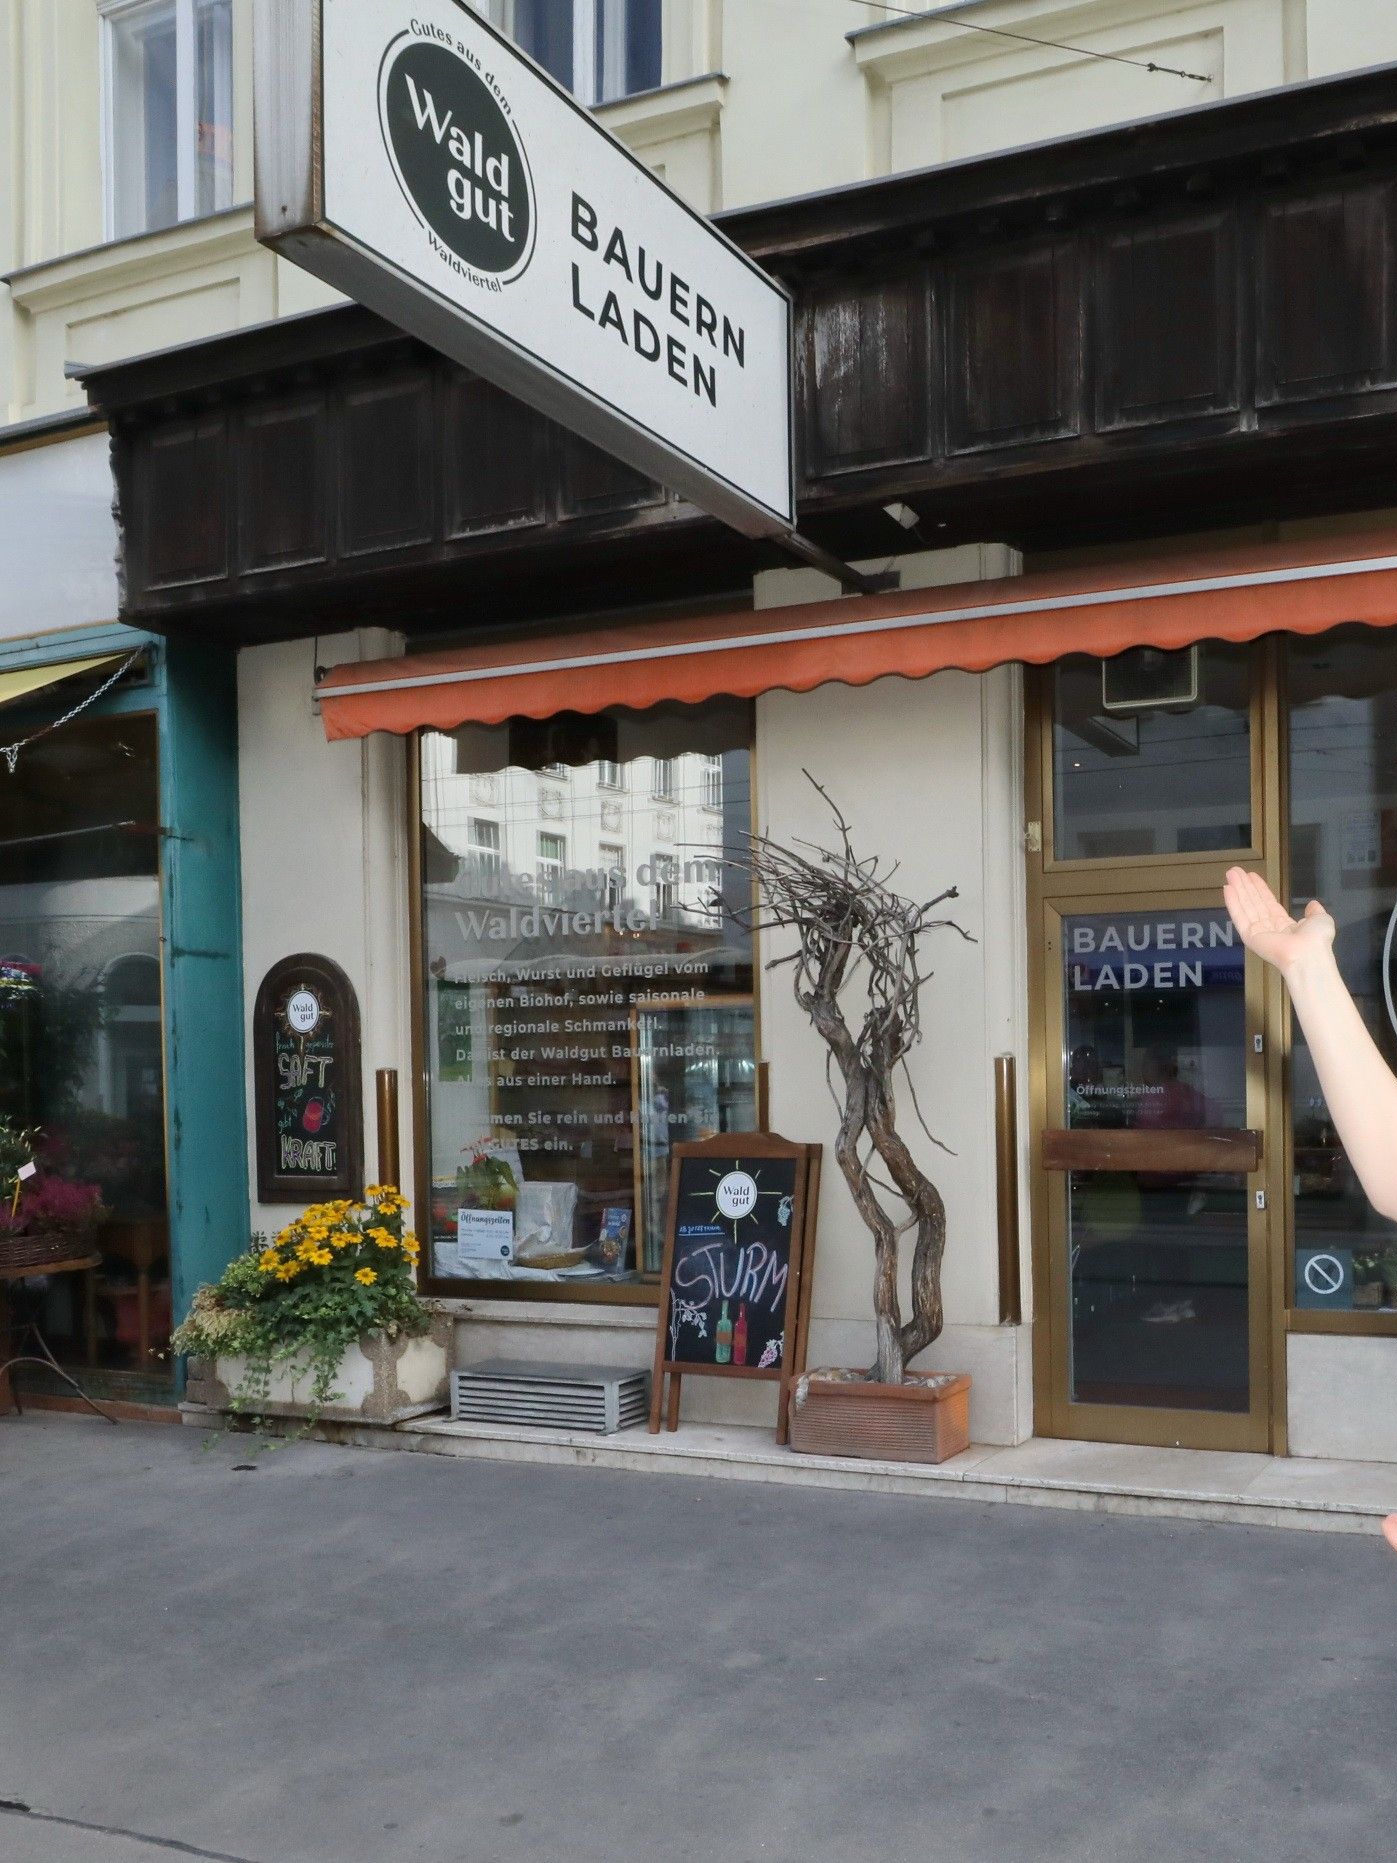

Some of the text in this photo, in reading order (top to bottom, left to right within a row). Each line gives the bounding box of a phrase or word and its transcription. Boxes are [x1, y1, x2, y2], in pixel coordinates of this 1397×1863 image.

[410, 18, 512, 115] Gutes aus dem
[404, 73, 510, 198] Wald
[446, 168, 515, 243] gut
[427, 228, 503, 293] Waldviertel
[571, 190, 745, 370] BAUERN
[571, 262, 717, 408] LADEN
[455, 900, 659, 942] Waldviertel
[1074, 920, 1234, 954] BAUERN
[516, 967, 562, 981] Wurst
[567, 965, 597, 979] und
[602, 961, 669, 979] Geflügel
[674, 962, 710, 975] vom
[1074, 961, 1203, 992] LADEN
[292, 1003, 314, 1013] Wald
[520, 993, 574, 1008] Biohof,
[579, 990, 624, 1005] sowie
[629, 987, 706, 1003] saisonale
[299, 1011, 315, 1022] gut
[489, 1020, 560, 1037] regionale
[487, 1047, 506, 1060] ist
[511, 1046, 535, 1060] der
[541, 1045, 607, 1061] Waldgut
[278, 1052, 334, 1090] SAFT
[497, 1075, 522, 1087] aus
[527, 1072, 567, 1087] einer
[572, 1071, 617, 1086] Hand.
[1076, 1083, 1164, 1096] Öffnungszeiten
[528, 1110, 552, 1124] Sie
[557, 1109, 588, 1124] rein
[593, 1110, 625, 1124] und
[543, 1136, 574, 1151] ein.
[723, 1185, 750, 1196] Wald
[732, 1195, 750, 1207] gut
[675, 1241, 789, 1313] STURM
